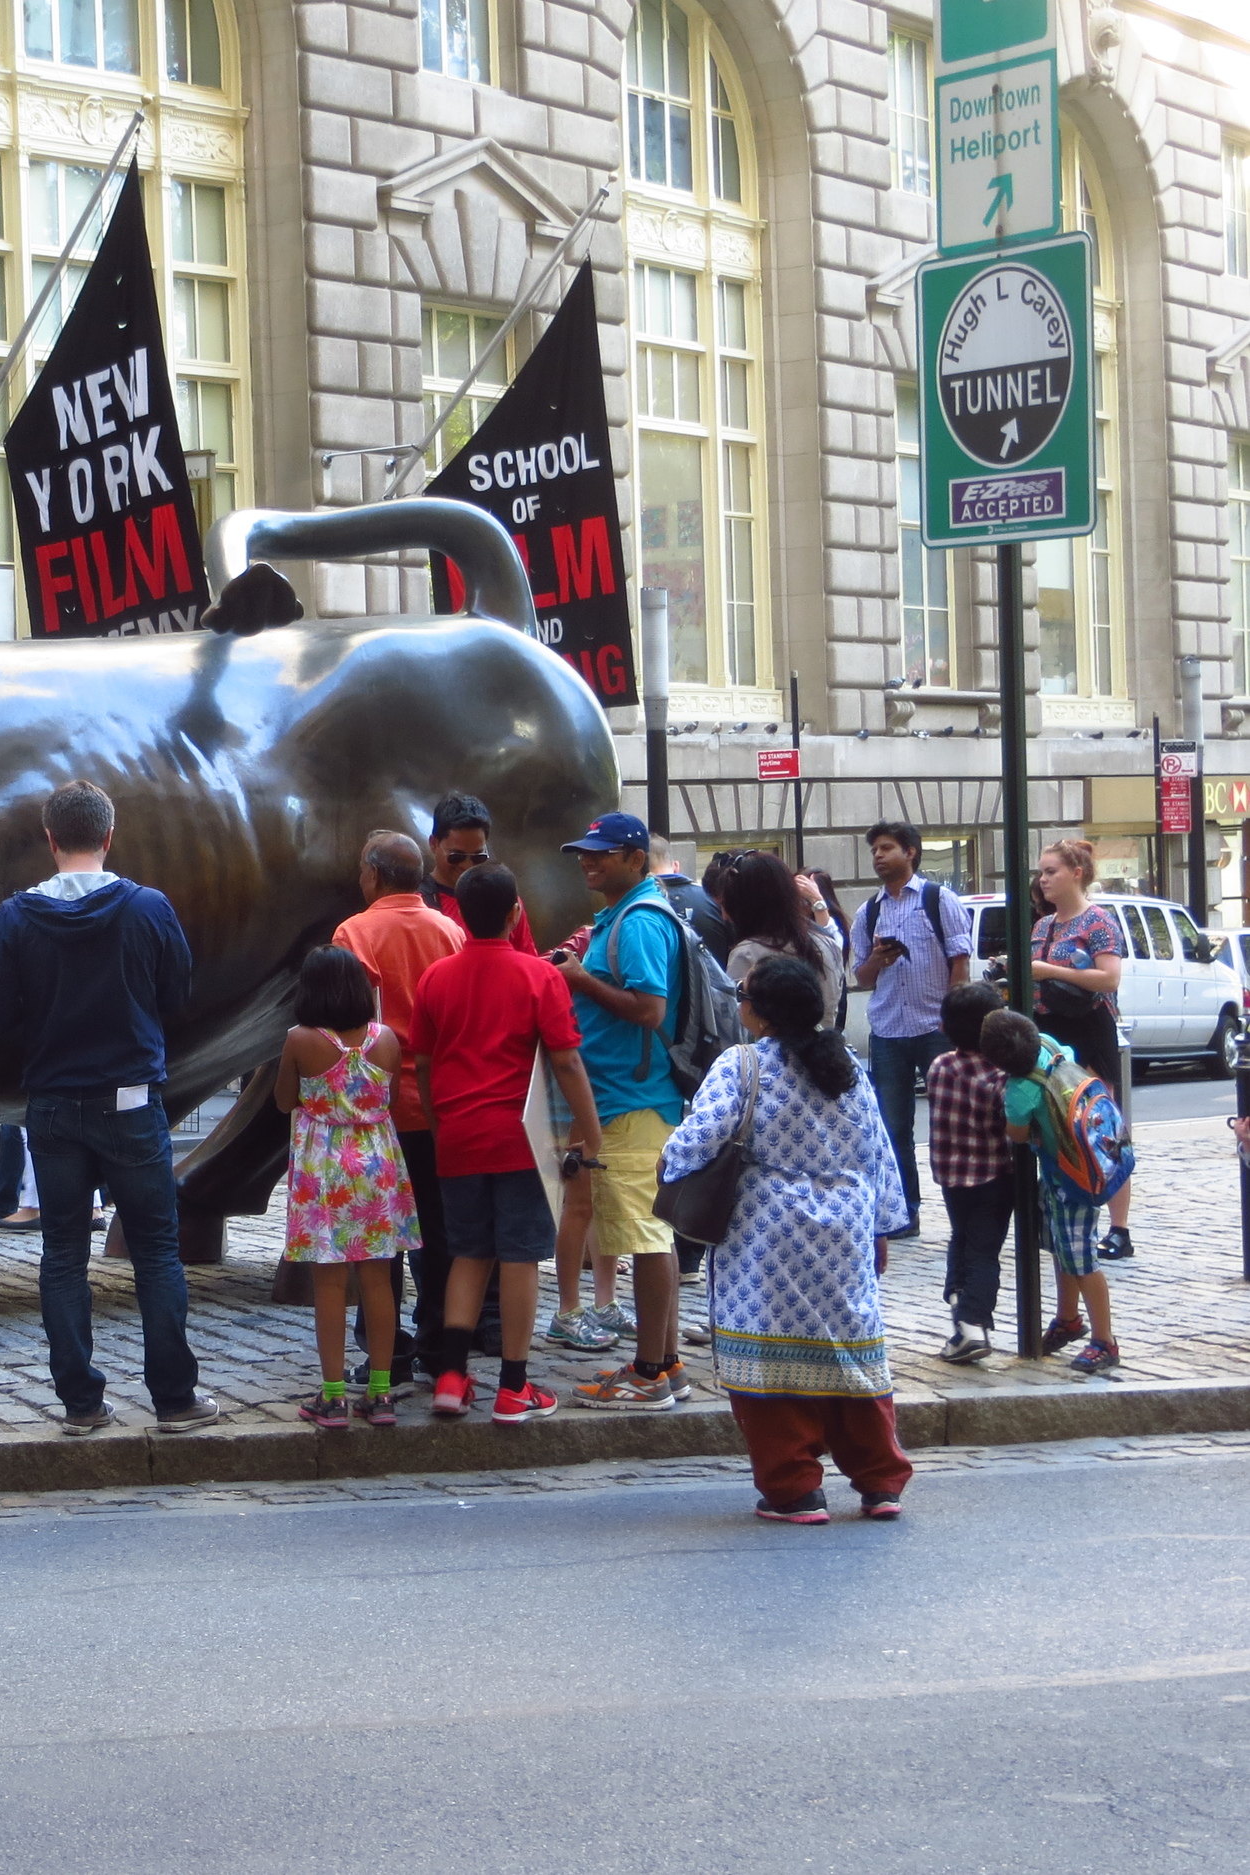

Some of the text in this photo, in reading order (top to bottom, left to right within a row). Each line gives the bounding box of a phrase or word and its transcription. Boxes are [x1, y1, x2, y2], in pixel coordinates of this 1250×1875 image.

[950, 84, 1040, 124] Downtown
[951, 119, 1041, 164] Heliport
[944, 277, 1066, 363] Hugh L Carey
[52, 347, 149, 451] NEW
[950, 367, 1061, 416] TUNNEL
[24, 425, 174, 533] YORK
[468, 432, 600, 492] SCHOOL
[512, 495, 541, 524] OF
[960, 495, 1054, 520] ACCEPTED
[35, 503, 193, 633] FILM
